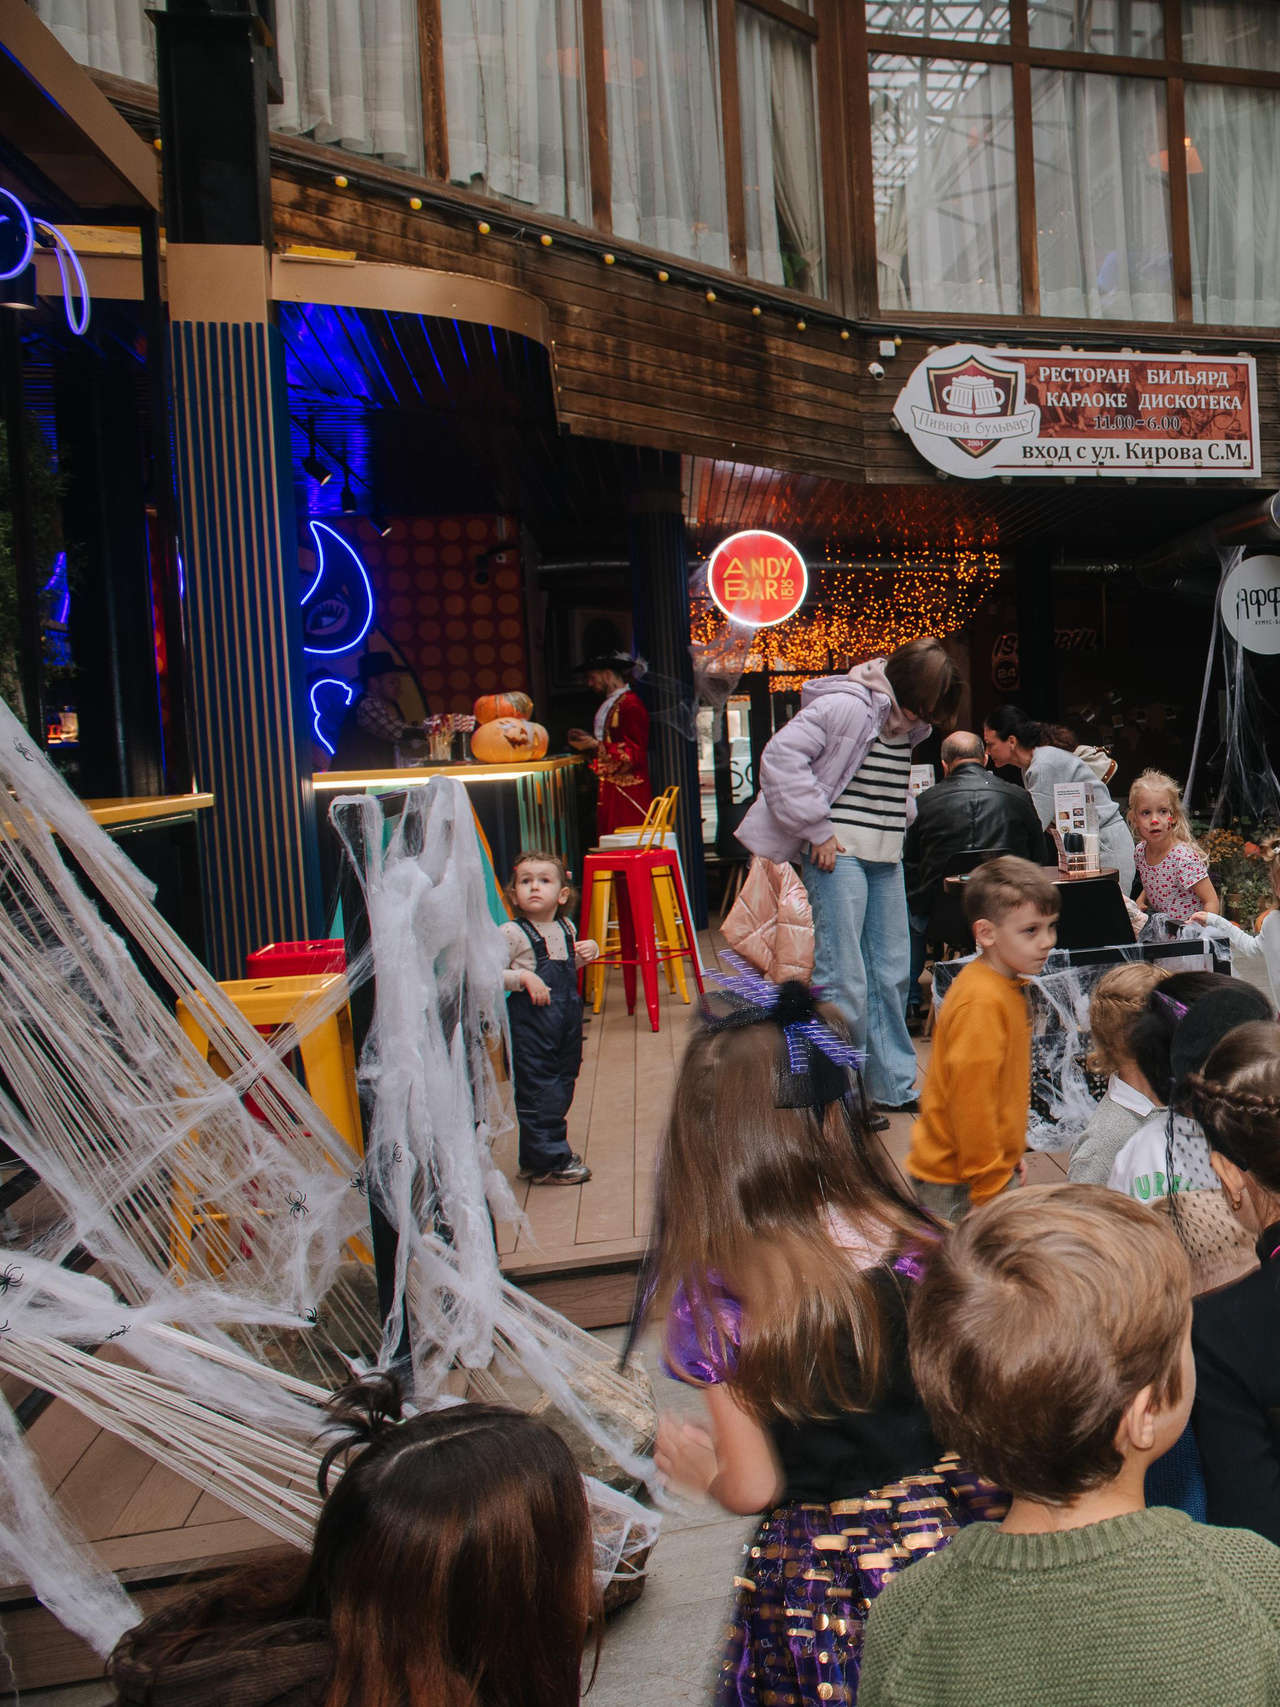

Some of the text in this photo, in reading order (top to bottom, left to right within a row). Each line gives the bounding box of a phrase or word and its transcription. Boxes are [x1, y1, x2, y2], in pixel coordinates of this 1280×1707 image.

[1039, 366, 1229, 388] РЕСТОРАН БИЛЬЯРД
[1046, 391, 1242, 411] КАРАОКЕ ДИСКОТЕКА
[919, 412, 1029, 438] Пивной бульвар
[1022, 442, 1248, 464] вход с ул. Кирова С.М.
[723, 557, 793, 578] ANDY
[724, 579, 779, 601] BAR
[781, 579, 794, 588] SO
